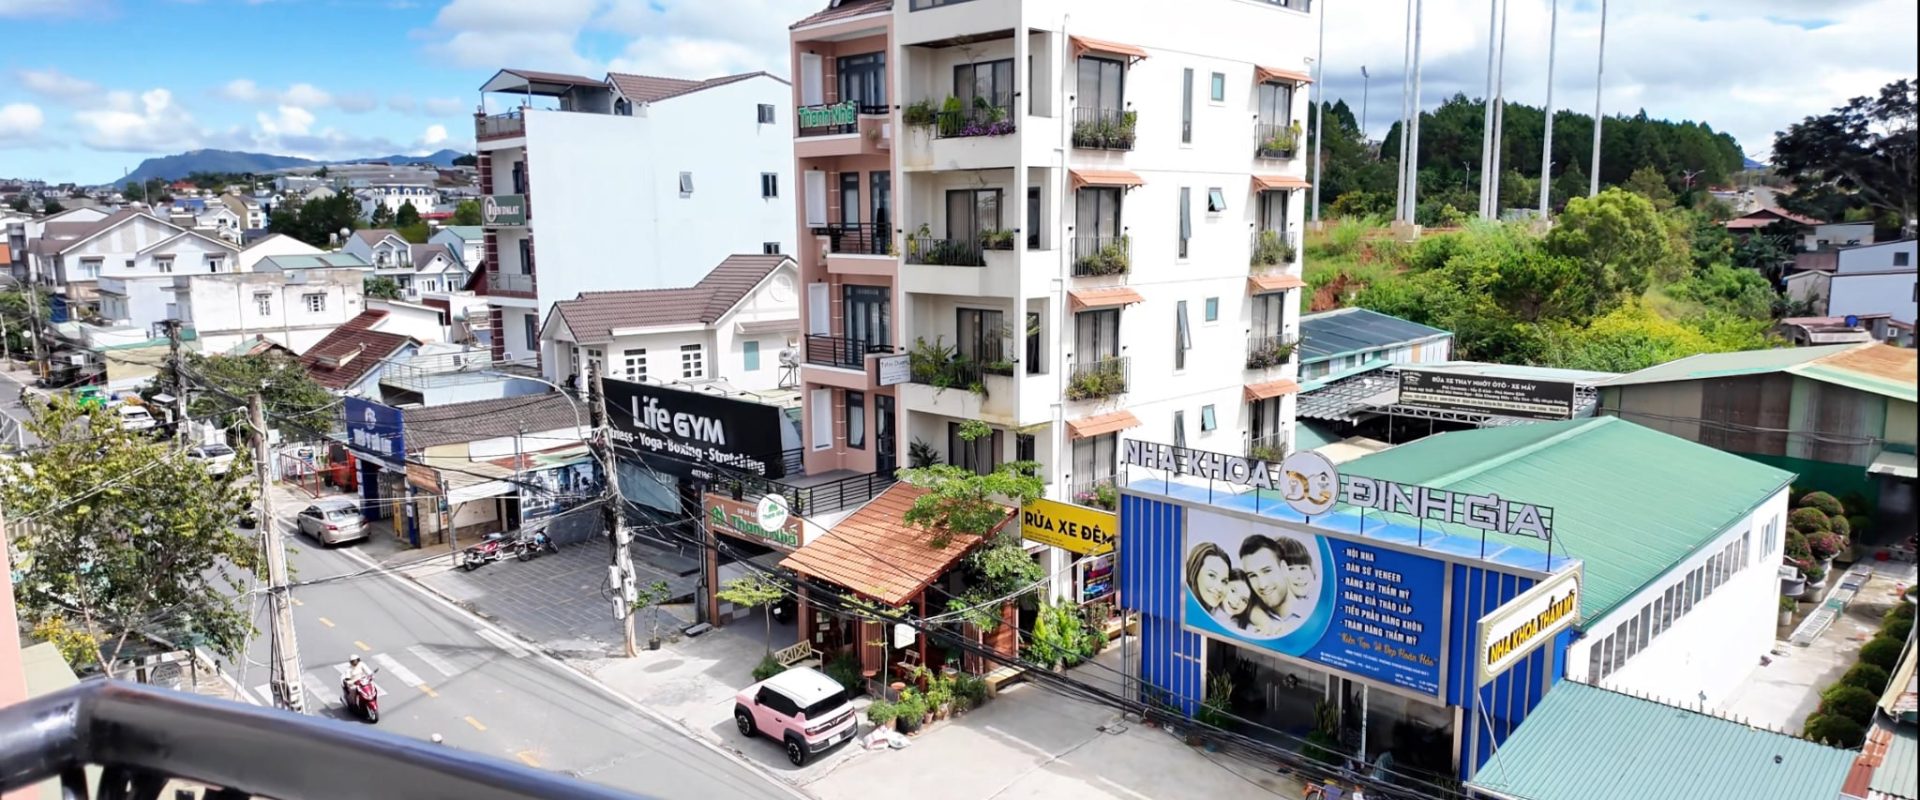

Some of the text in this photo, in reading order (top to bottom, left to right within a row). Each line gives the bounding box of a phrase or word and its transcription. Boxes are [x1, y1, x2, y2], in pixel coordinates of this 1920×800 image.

[632, 395, 726, 445] Life GYM
[639, 432, 663, 451] Yoga
[667, 440, 703, 462] Boxing
[709, 447, 766, 476] Stretching
[1123, 439, 1178, 473] NHA
[1187, 449, 1274, 491] KHOA
[1347, 476, 1454, 523] ĐINH
[1025, 508, 1054, 532] RỬA
[1058, 519, 1078, 537] XE
[1081, 524, 1116, 548] ĐÊM
[1375, 569, 1401, 583] VENEER
[1488, 636, 1511, 665] NHA
[1510, 619, 1537, 650] KHOA
